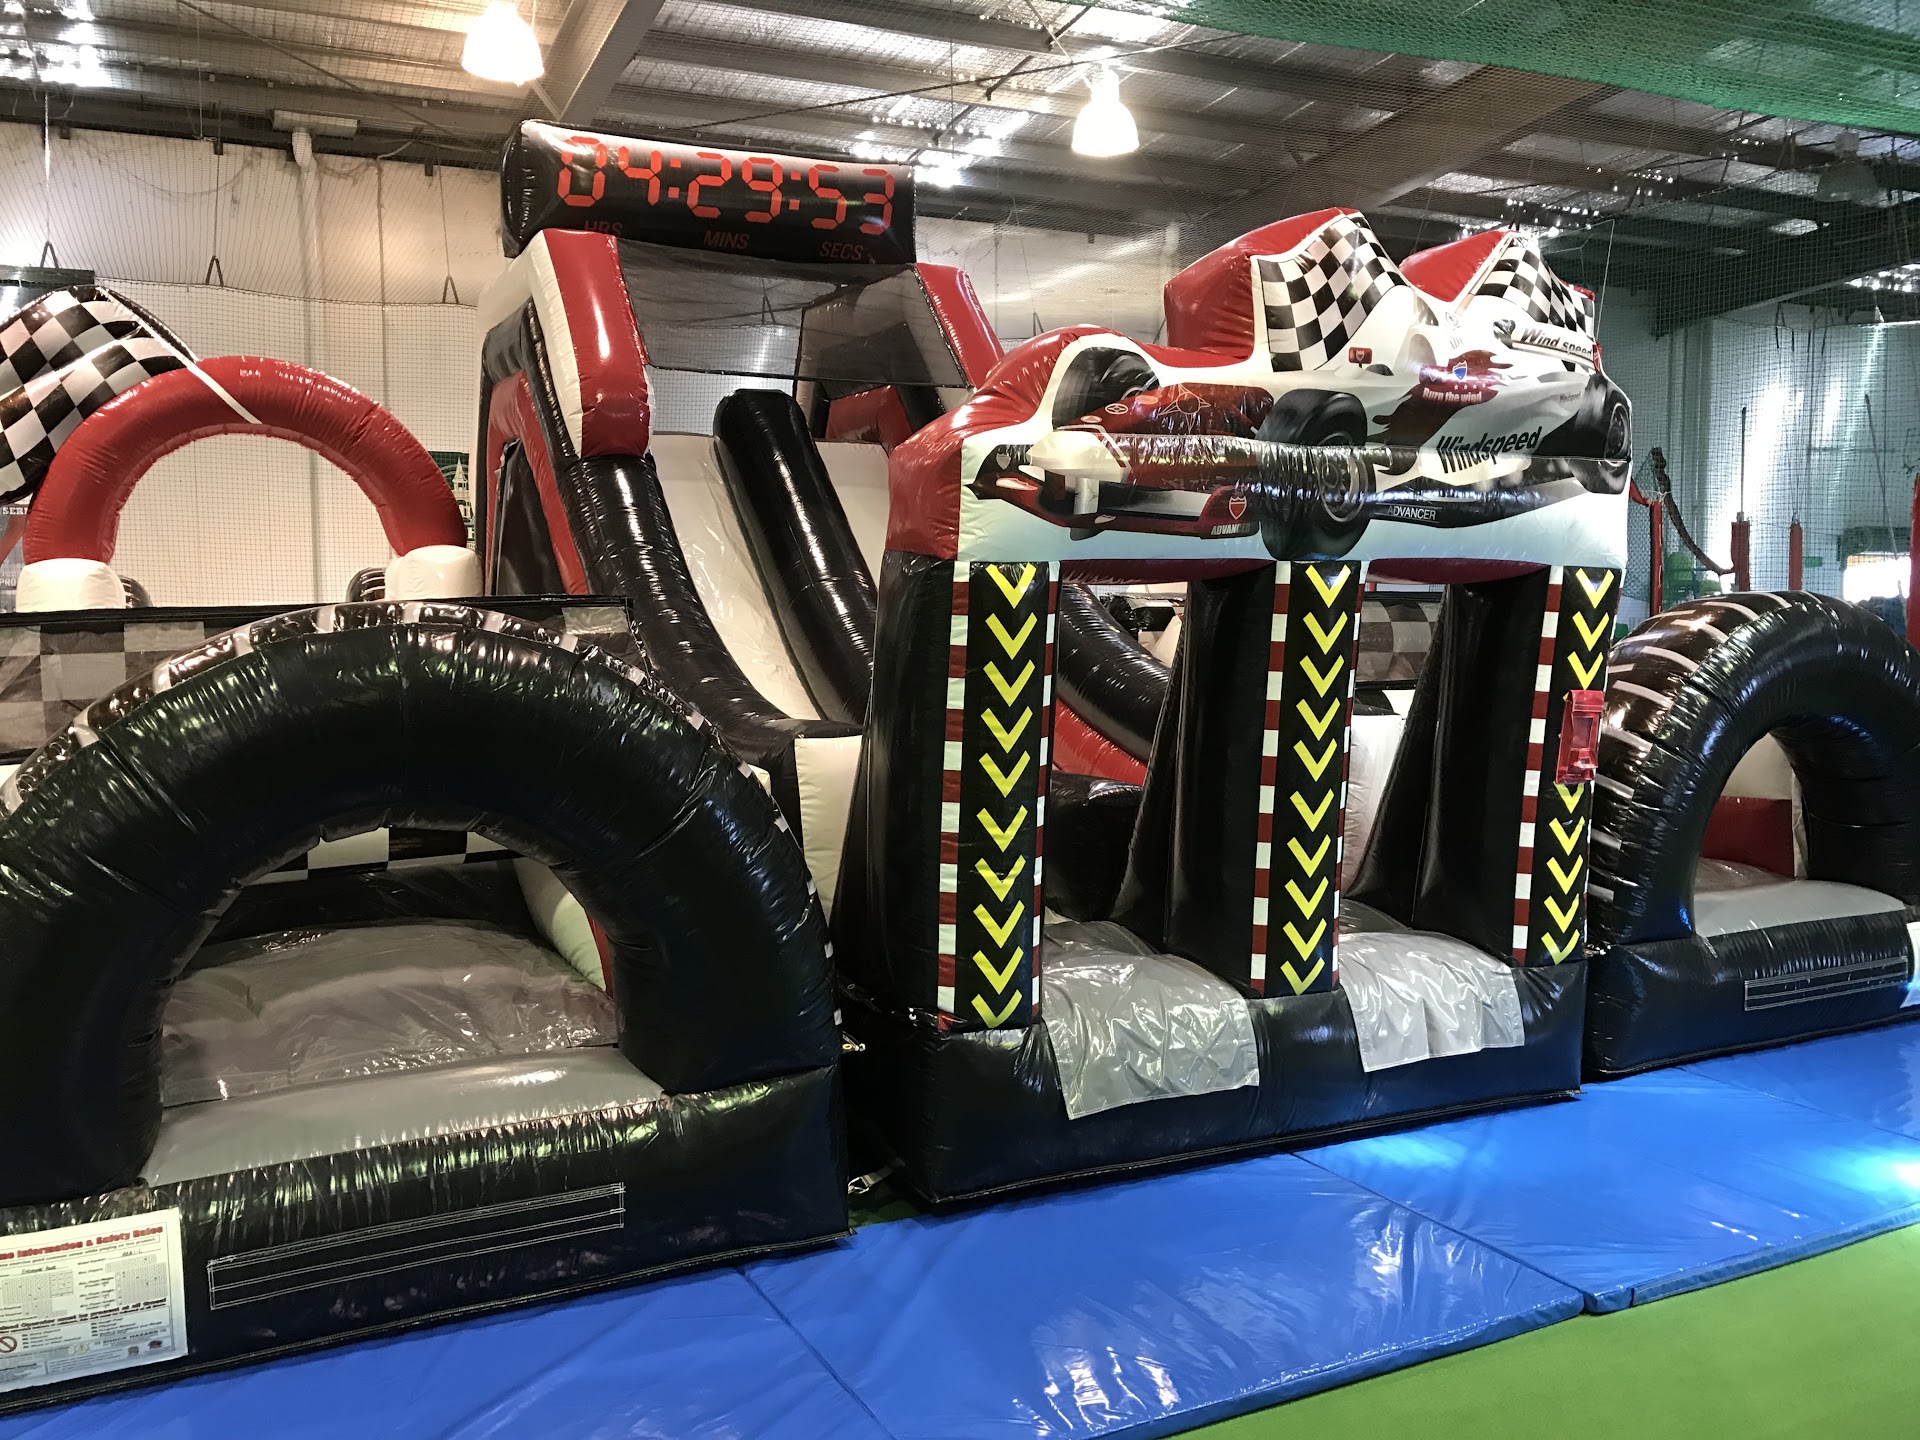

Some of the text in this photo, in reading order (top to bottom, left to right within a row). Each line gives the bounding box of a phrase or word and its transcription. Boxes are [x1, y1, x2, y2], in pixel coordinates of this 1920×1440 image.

[557, 135, 894, 235] 04:29:53
[703, 230, 750, 250] MINS
[819, 241, 864, 261] SECS
[1521, 327, 1561, 347] Wind
[1445, 391, 1459, 402] the
[1460, 391, 1482, 403] wind
[1436, 426, 1542, 473] Windspeed
[1387, 505, 1437, 520] ADVANCER
[96, 1232, 130, 1245] Safety
